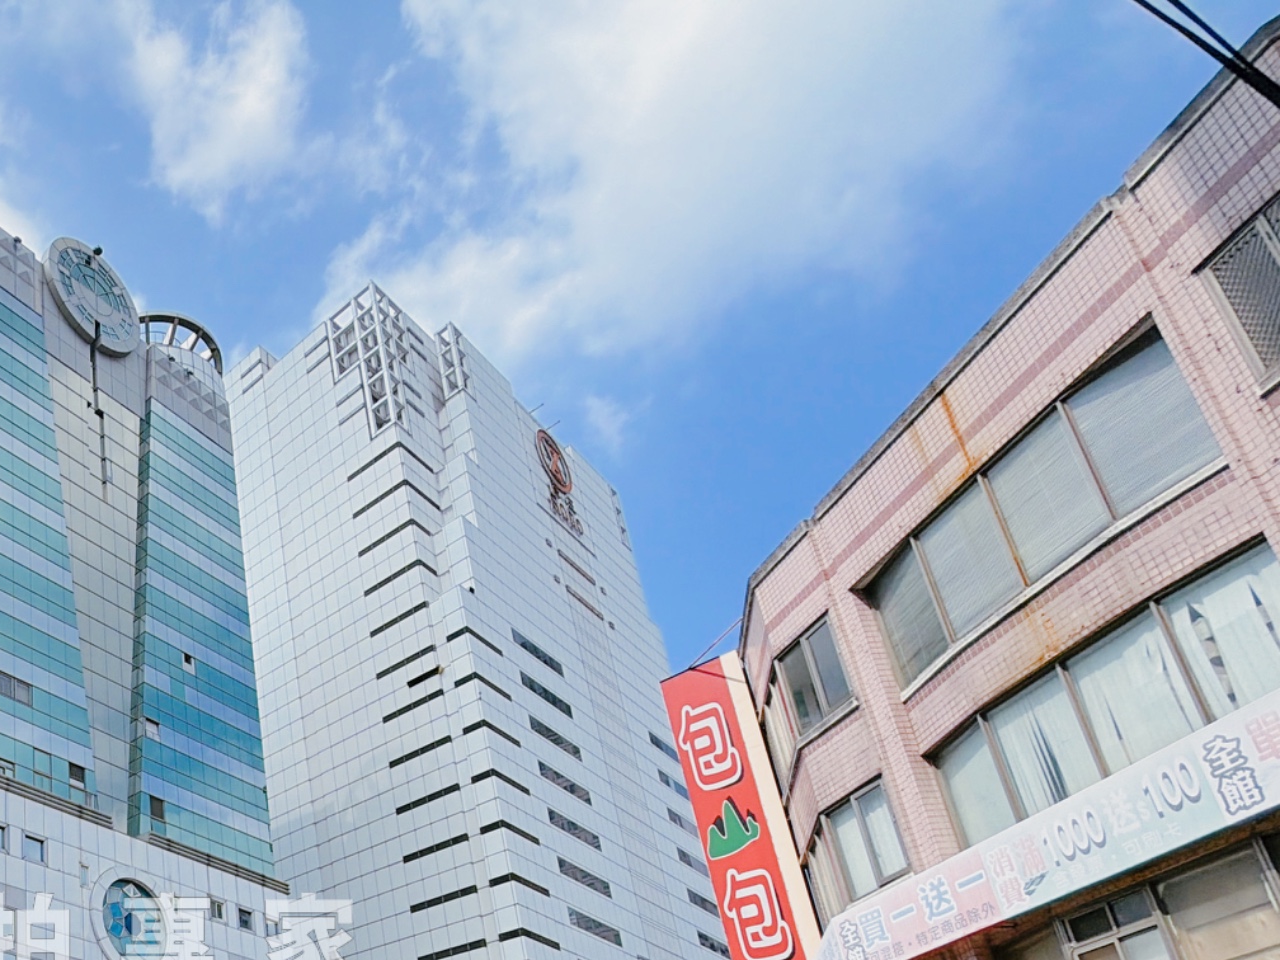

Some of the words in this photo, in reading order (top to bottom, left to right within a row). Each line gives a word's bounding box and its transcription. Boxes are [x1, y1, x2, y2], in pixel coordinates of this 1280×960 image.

[1202, 734, 1266, 816] 全館
[857, 871, 986, 949] 買一送一
